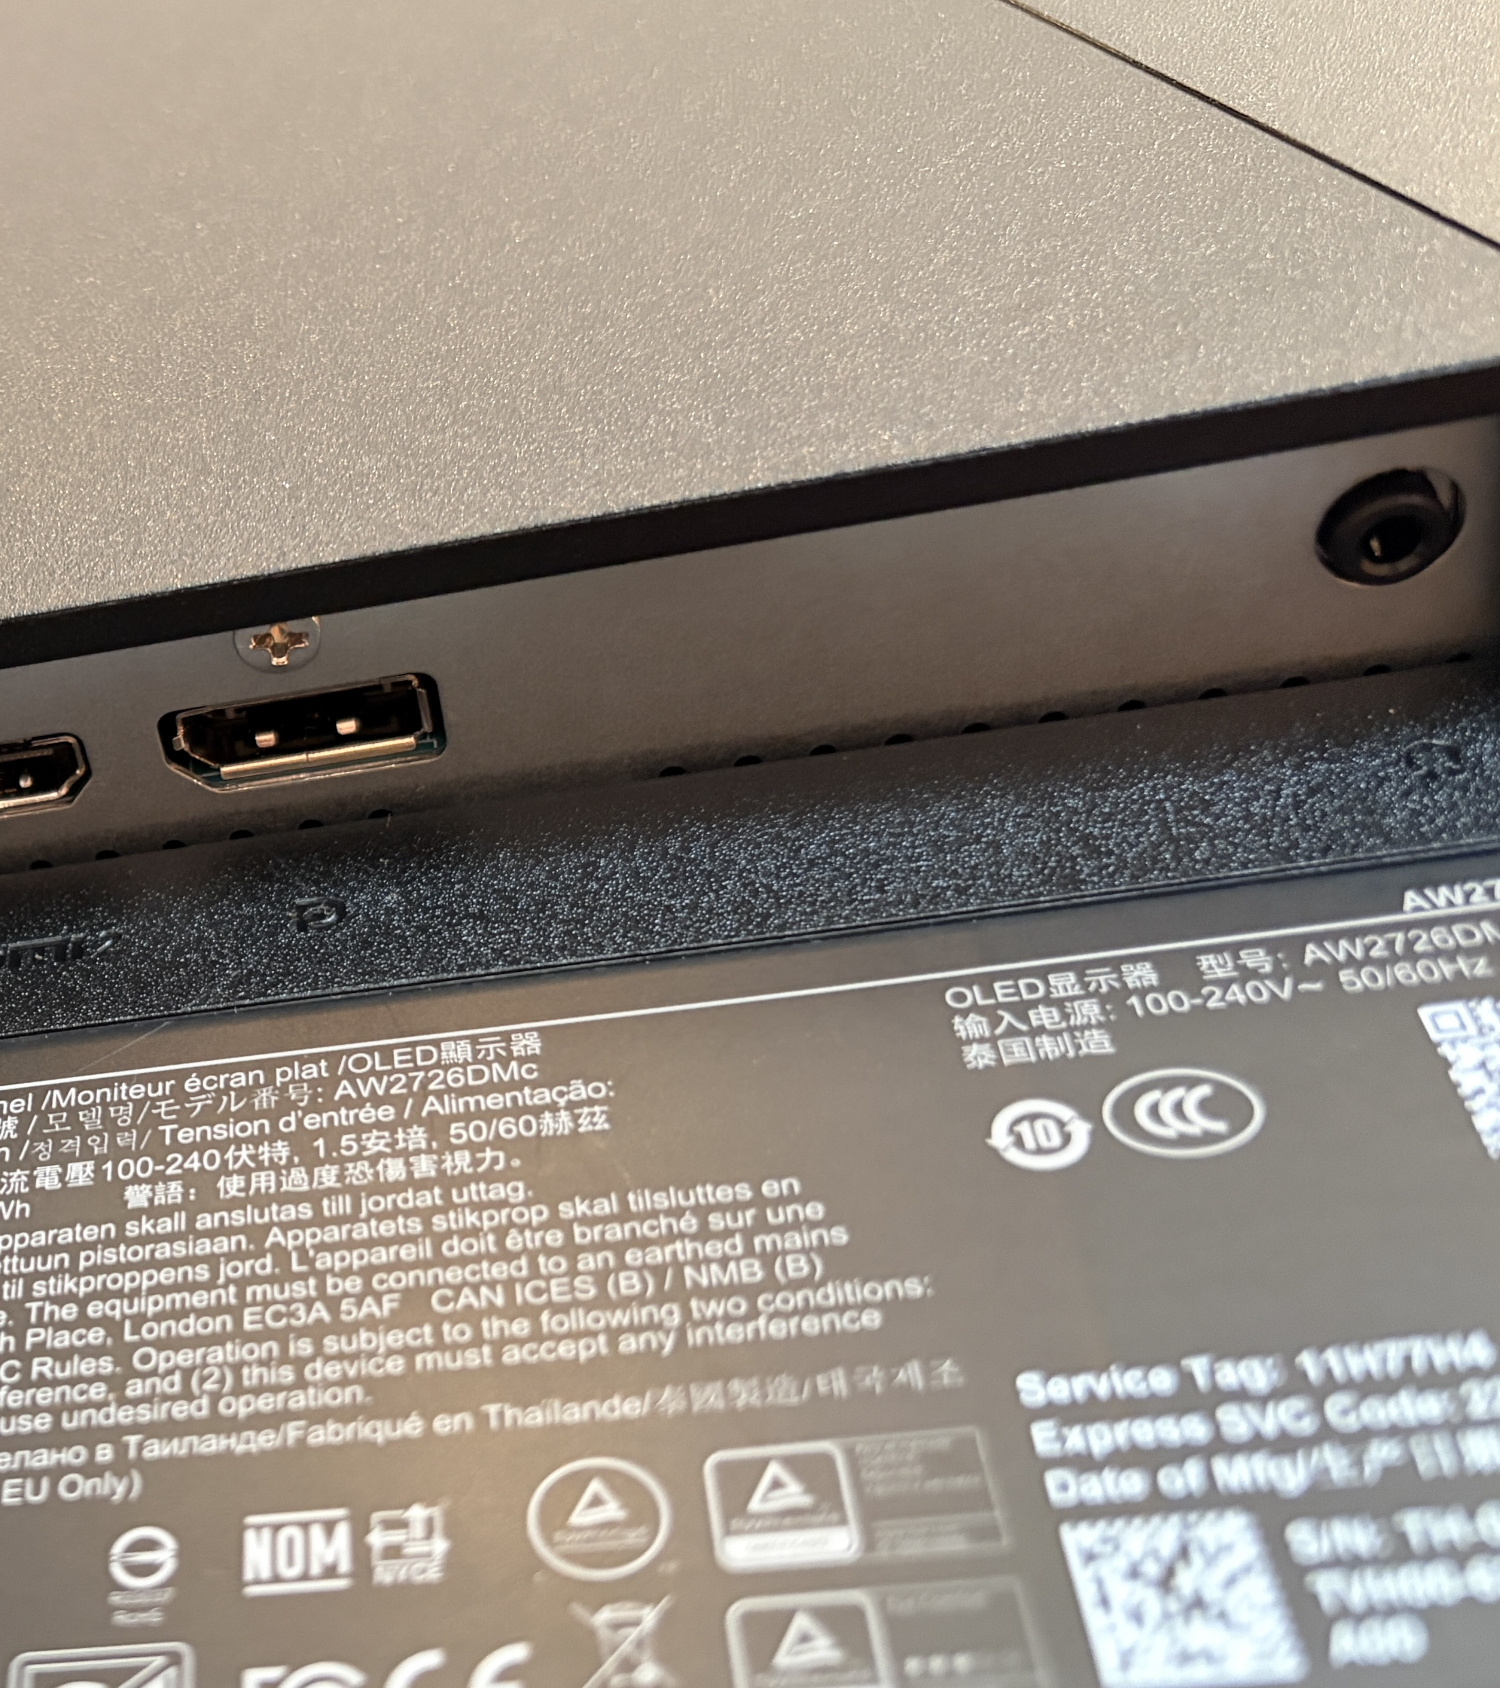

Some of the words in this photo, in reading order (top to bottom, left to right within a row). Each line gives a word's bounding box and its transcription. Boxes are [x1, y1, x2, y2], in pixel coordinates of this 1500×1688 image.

[1338, 953, 1496, 997] 50/60Hz
[961, 1030, 1118, 1071] 泰国制造
[40, 1079, 176, 1116] /Moniteur
[184, 1069, 265, 1093] écran
[275, 1058, 329, 1088] plat
[333, 1060, 539, 1101] AW2726DMc
[157, 1117, 271, 1146] Tension
[278, 1102, 396, 1133] d'entrée
[78, 1234, 255, 1273] pistorasiaan.
[264, 1214, 423, 1256] Apparatets
[431, 1197, 550, 1237] stikprop
[557, 1191, 619, 1220] skal
[627, 1182, 753, 1213] tilsluttes
[761, 1177, 801, 1198] en
[125, 1210, 187, 1238] skall
[195, 1202, 314, 1231] anslutas
[322, 1193, 352, 1218] till
[360, 1185, 444, 1219] jordat
[451, 1180, 533, 1209] uttag.
[2, 1277, 24, 1301] til
[30, 1263, 211, 1306] stikproppens
[218, 1252, 280, 1286] jord.
[290, 1237, 433, 1278] L'appareil
[441, 1227, 498, 1258] doit
[505, 1222, 564, 1252] être
[572, 1210, 698, 1245] branché
[707, 1208, 757, 1231] sur
[765, 1201, 825, 1225] une
[30, 1296, 81, 1324] The
[86, 1281, 238, 1323] equipment
[245, 1276, 318, 1303] must
[326, 1268, 363, 1296] be
[371, 1254, 529, 1292] connected
[537, 1253, 568, 1276] to
[576, 1250, 616, 1272] an
[624, 1232, 744, 1267] earthed
[753, 1225, 849, 1254] mains
[123, 1312, 233, 1343] London
[243, 1300, 332, 1332] EC3A
[340, 1292, 400, 1322] 5AF
[430, 1283, 505, 1314] CAN
[515, 1274, 598, 1306] ICES
[607, 1270, 655, 1300] (B)
[683, 1258, 765, 1290] NMB
[774, 1252, 823, 1284] (B)
[1015, 1363, 1180, 1409] Service
[432, 1411, 474, 1434] en
[1030, 1411, 1215, 1460] Express
[1, 1476, 50, 1506] EU
[57, 1469, 143, 1503] Only)
[243, 1519, 353, 1585] NOM
